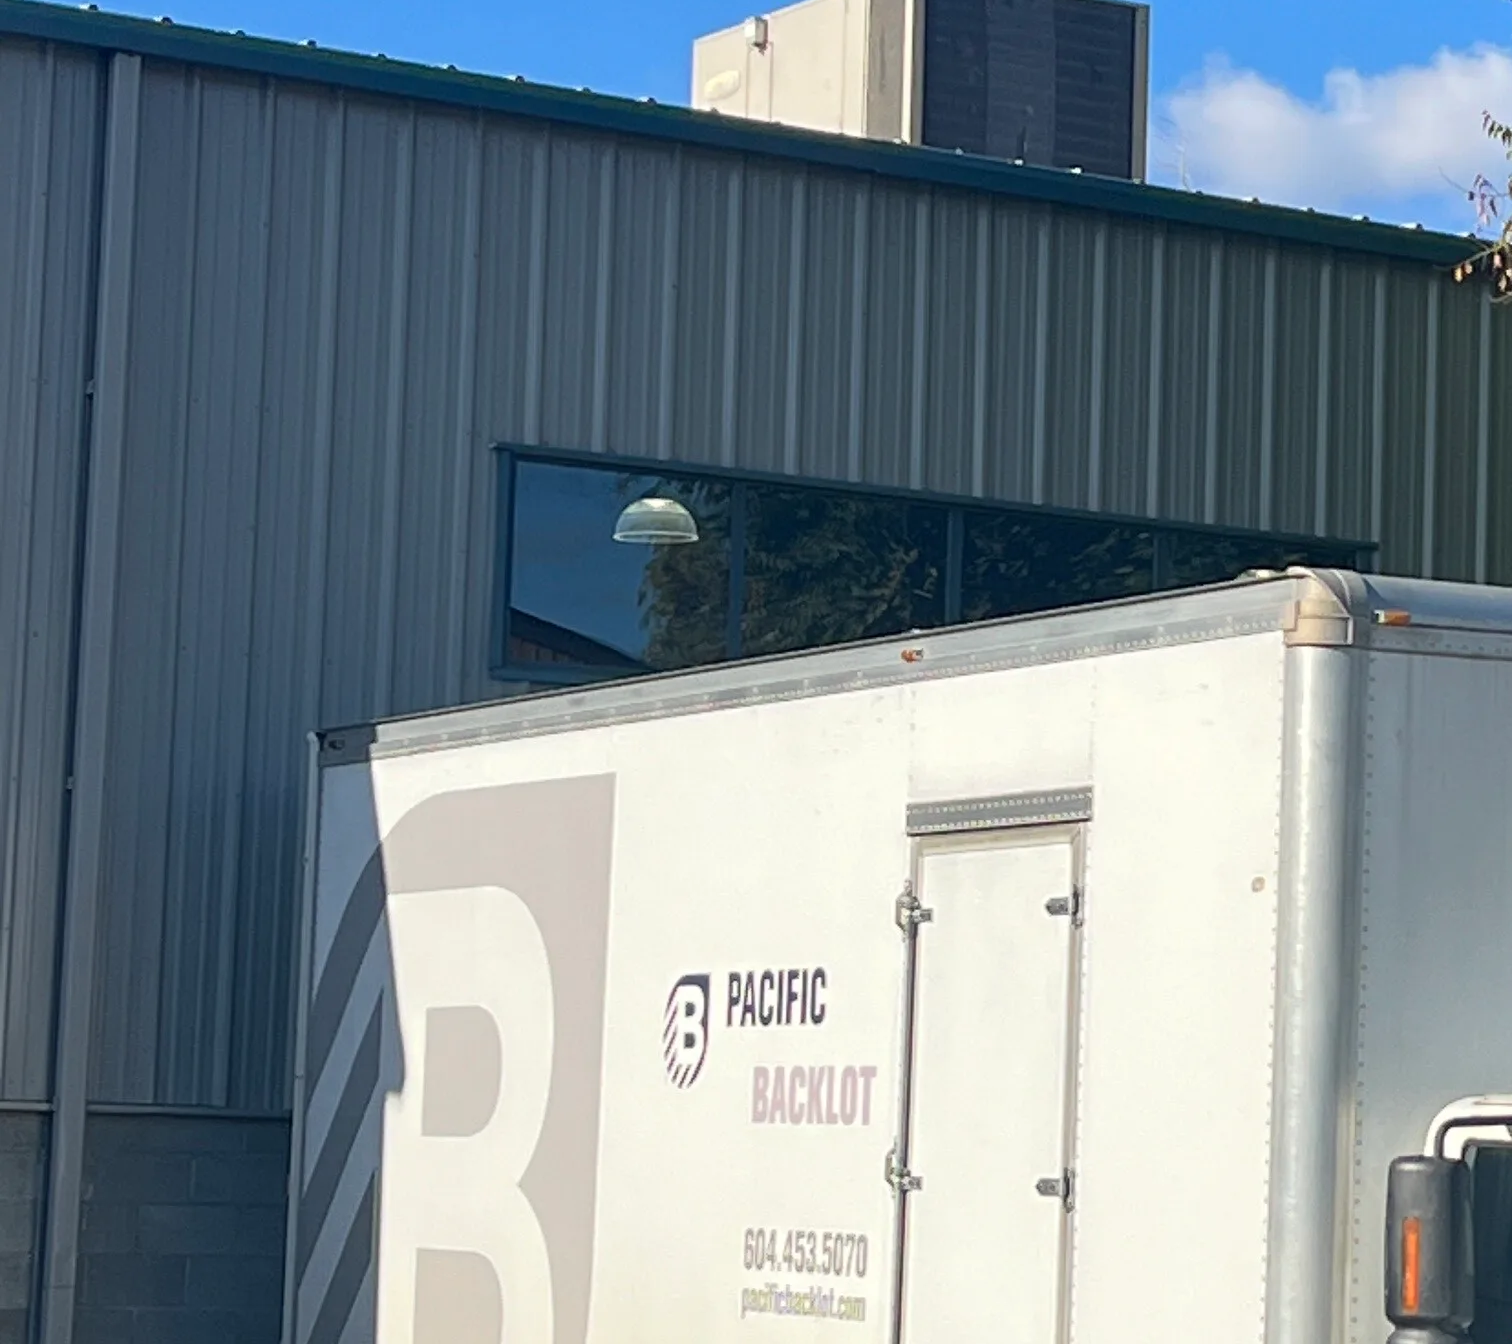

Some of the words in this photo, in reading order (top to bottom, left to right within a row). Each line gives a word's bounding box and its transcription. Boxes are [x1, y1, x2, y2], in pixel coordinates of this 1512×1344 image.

[726, 967, 827, 1027] PACIFIC
[752, 1065, 878, 1126] BACKLOT
[743, 1227, 869, 1278] 604.453.5070
